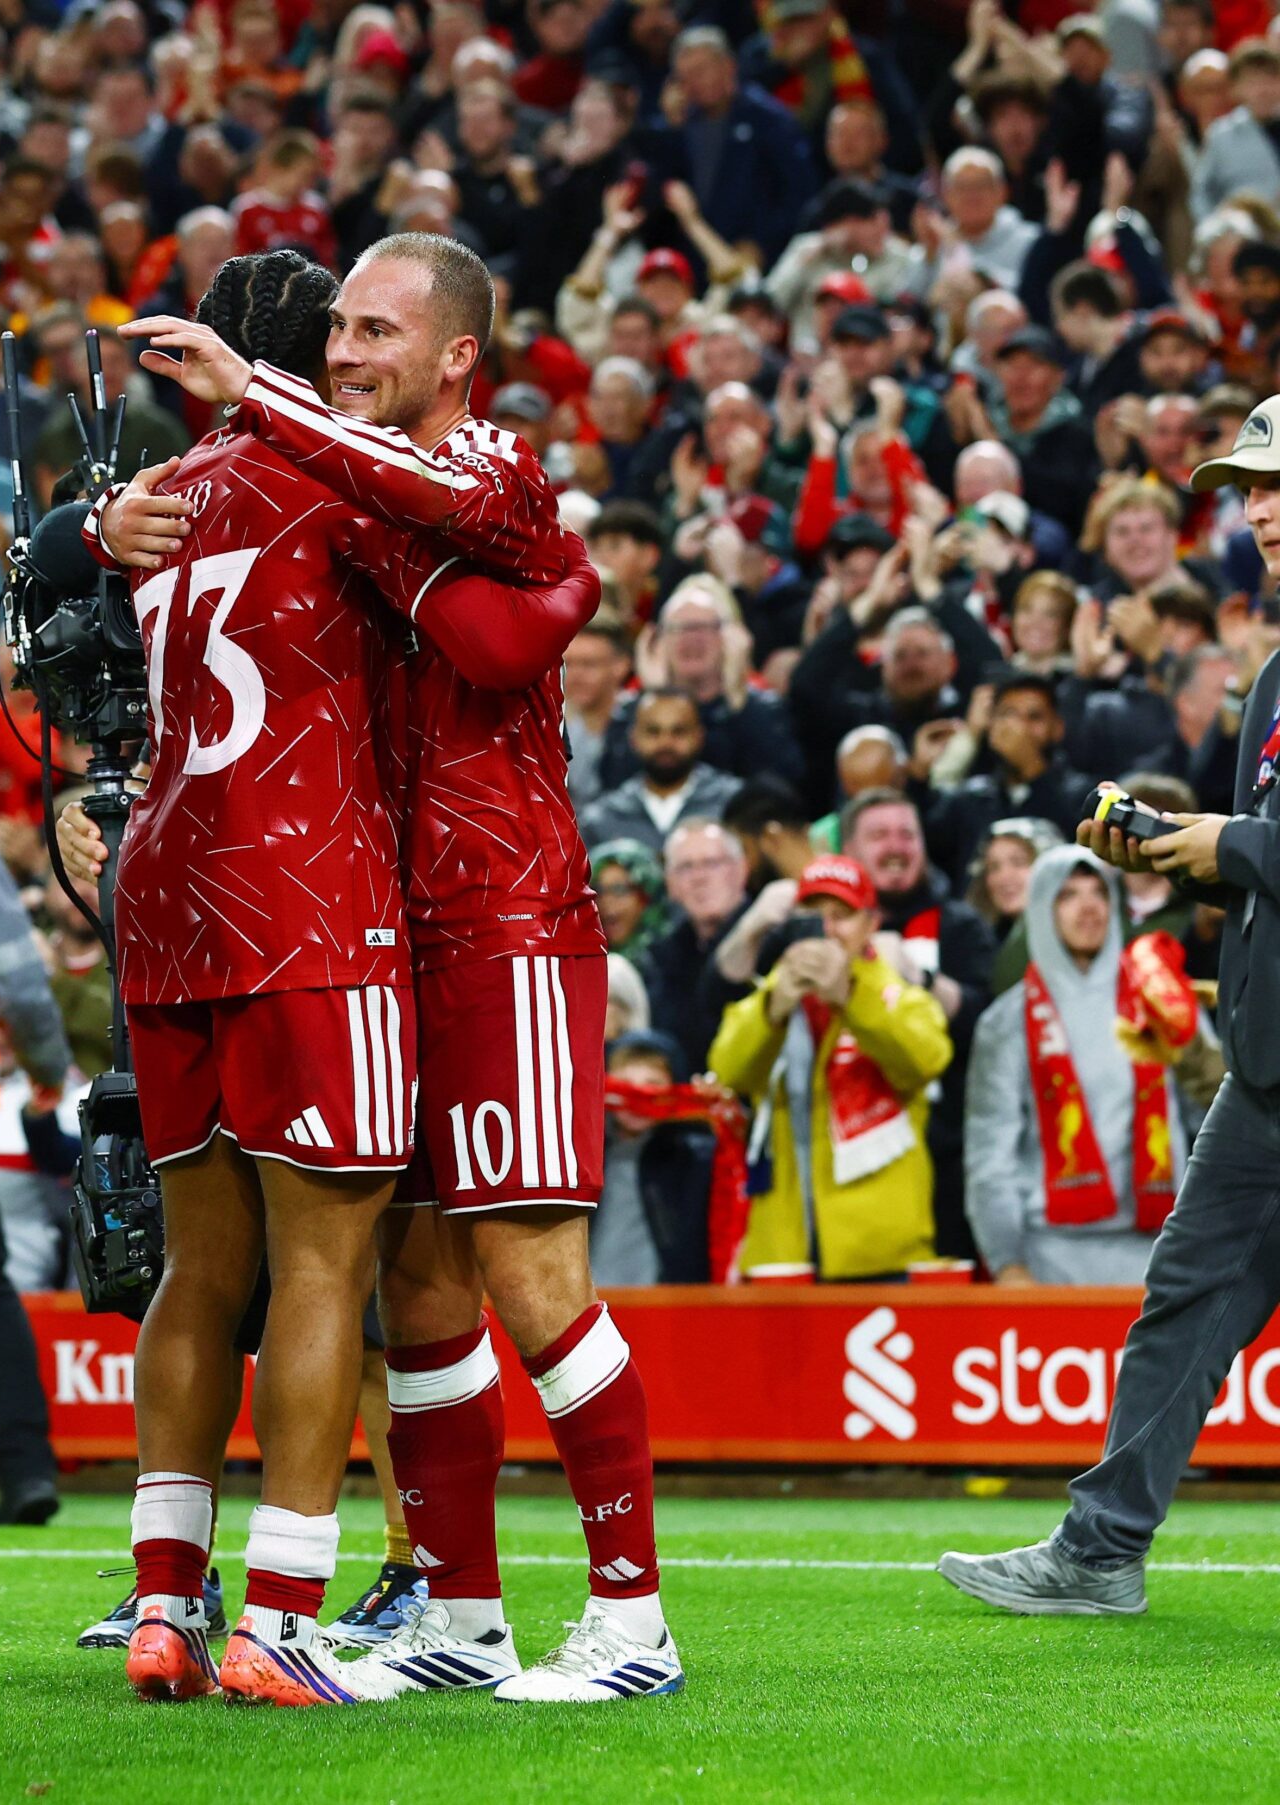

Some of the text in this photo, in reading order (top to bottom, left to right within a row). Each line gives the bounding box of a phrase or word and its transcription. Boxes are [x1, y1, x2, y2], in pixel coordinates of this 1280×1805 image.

[132, 547, 267, 776] 73
[447, 1100, 514, 1191] 10
[576, 1492, 633, 1522] LFC
